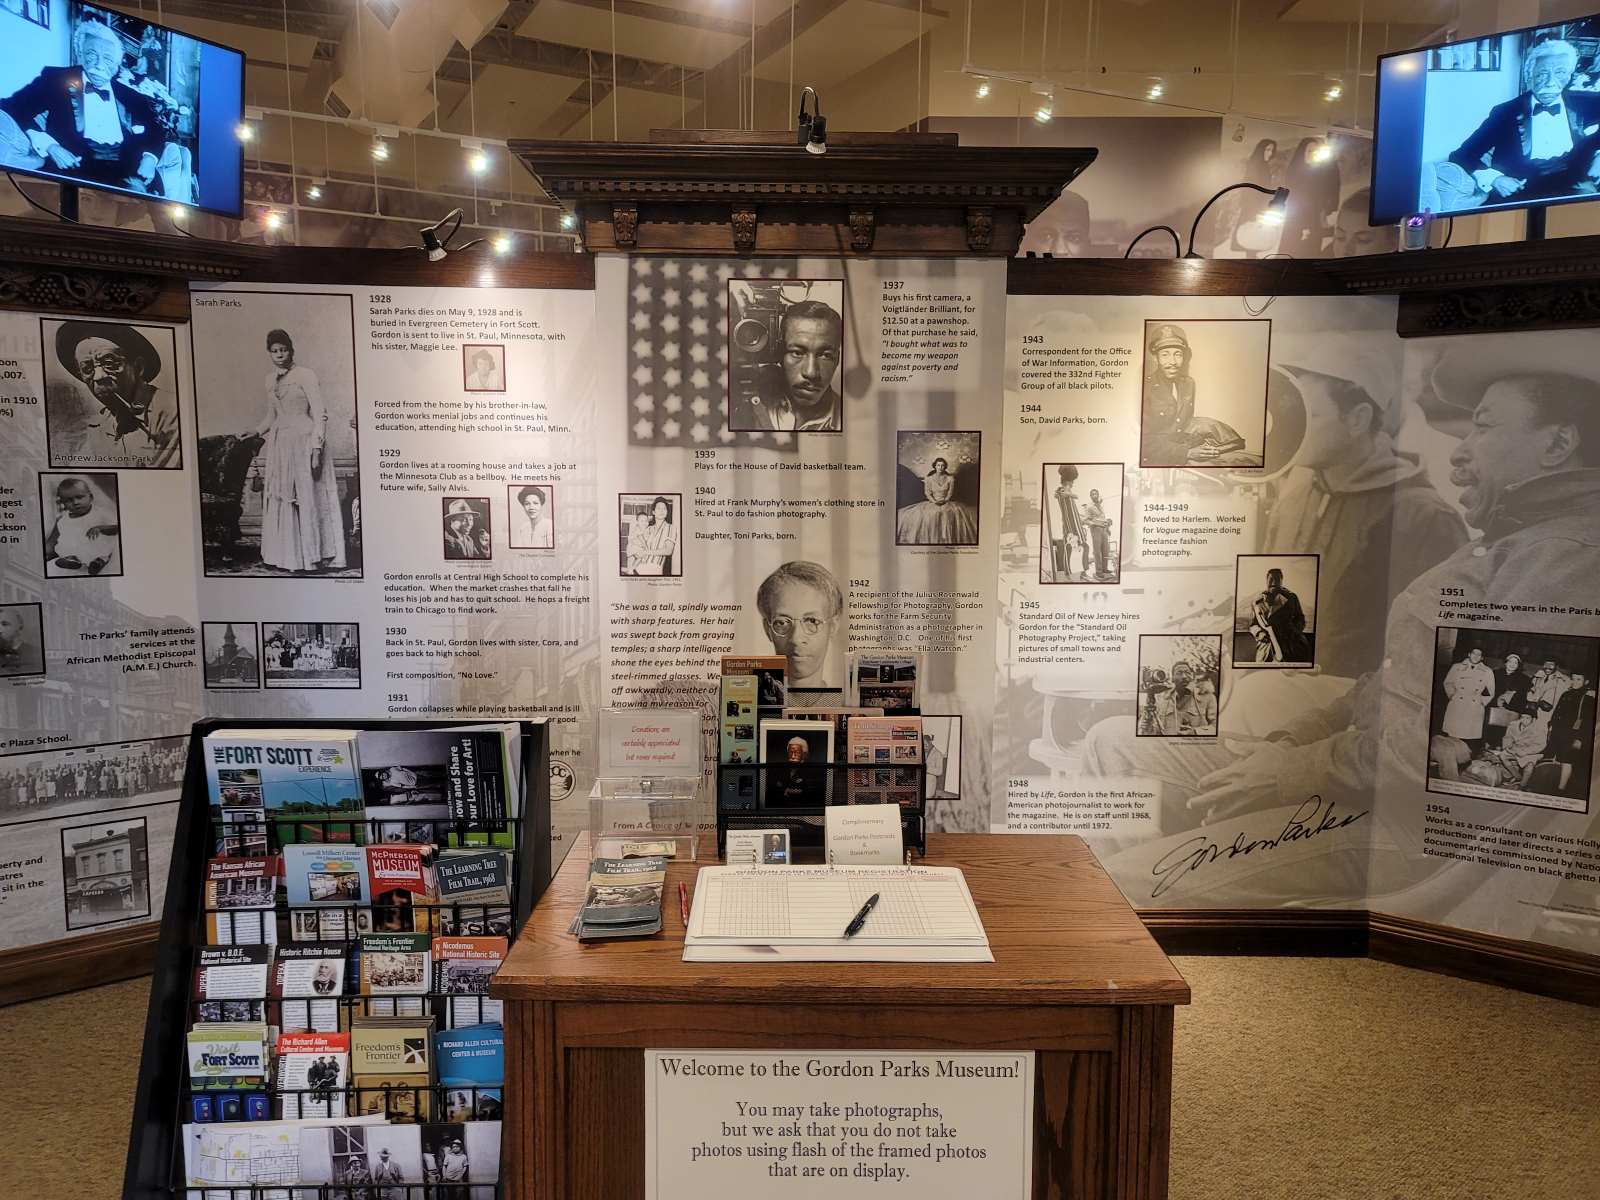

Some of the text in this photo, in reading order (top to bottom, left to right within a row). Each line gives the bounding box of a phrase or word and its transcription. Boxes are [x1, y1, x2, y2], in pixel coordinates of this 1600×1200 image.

[370, 295, 391, 303] 1928
[882, 293, 900, 302] Buys
[903, 293, 914, 301] his
[916, 293, 931, 301] first
[1023, 336, 1043, 344] 1943
[13, 396, 37, 405] 1910
[1020, 404, 1041, 412] 1944
[1020, 416, 1107, 425] Son, David Parks, born.
[55, 454, 92, 462] Andrew
[93, 454, 128, 462] Jackson
[695, 451, 715, 459] 1939
[694, 462, 713, 471] Plays
[715, 462, 726, 470] for
[728, 462, 741, 470] the
[744, 462, 766, 470] House
[768, 462, 777, 470] of
[779, 462, 801, 470] David
[803, 462, 842, 471] basketball
[695, 487, 715, 495] 1940
[1144, 504, 1189, 512] 1944-1949
[695, 532, 731, 541] Daughter,
[752, 532, 775, 541] Parks,
[778, 532, 796, 540] born.
[1142, 549, 1192, 558] photography.
[1440, 587, 1464, 596] 1951
[1020, 601, 1040, 609] 1945
[611, 616, 735, 627] with sharp features. Her hair
[1438, 611, 1503, 623] Life magazine.
[66, 648, 196, 665] African Methodist Episcopal
[122, 660, 196, 674] (A.M.E.) Church.
[387, 671, 402, 679] First
[404, 671, 456, 680] composition,
[388, 694, 408, 702] 1931
[9, 734, 72, 747] Plaza School.
[214, 746, 225, 764] THE
[225, 747, 262, 764] FORT
[268, 747, 312, 765] SCOTT
[450, 746, 460, 776] Share
[298, 765, 332, 773] EXPERIENCE
[464, 761, 474, 776] for
[451, 777, 463, 798] and
[467, 778, 477, 802] Love
[1426, 804, 1450, 815] 1954
[1152, 835, 1284, 898] Gordon
[1278, 794, 1370, 845] Parks
[1424, 847, 1522, 871] Educational Television
[222, 862, 243, 870] Kansas
[245, 860, 266, 868] African
[372, 859, 420, 871] MUSEUM
[210, 869, 263, 879] American Museum
[442, 950, 500, 958] National Historic Site
[292, 1038, 313, 1046] Richard
[206, 1043, 241, 1055] Visit
[366, 1052, 400, 1060] Frontier
[660, 1058, 1020, 1079] Welcome to the Gordon Parks Museum!
[736, 1101, 943, 1121] You may take photographs,
[722, 1122, 957, 1142] but we ask that you do not take
[691, 1142, 987, 1161] photos using flash of the framed photos
[768, 1164, 910, 1181] that are on display.
